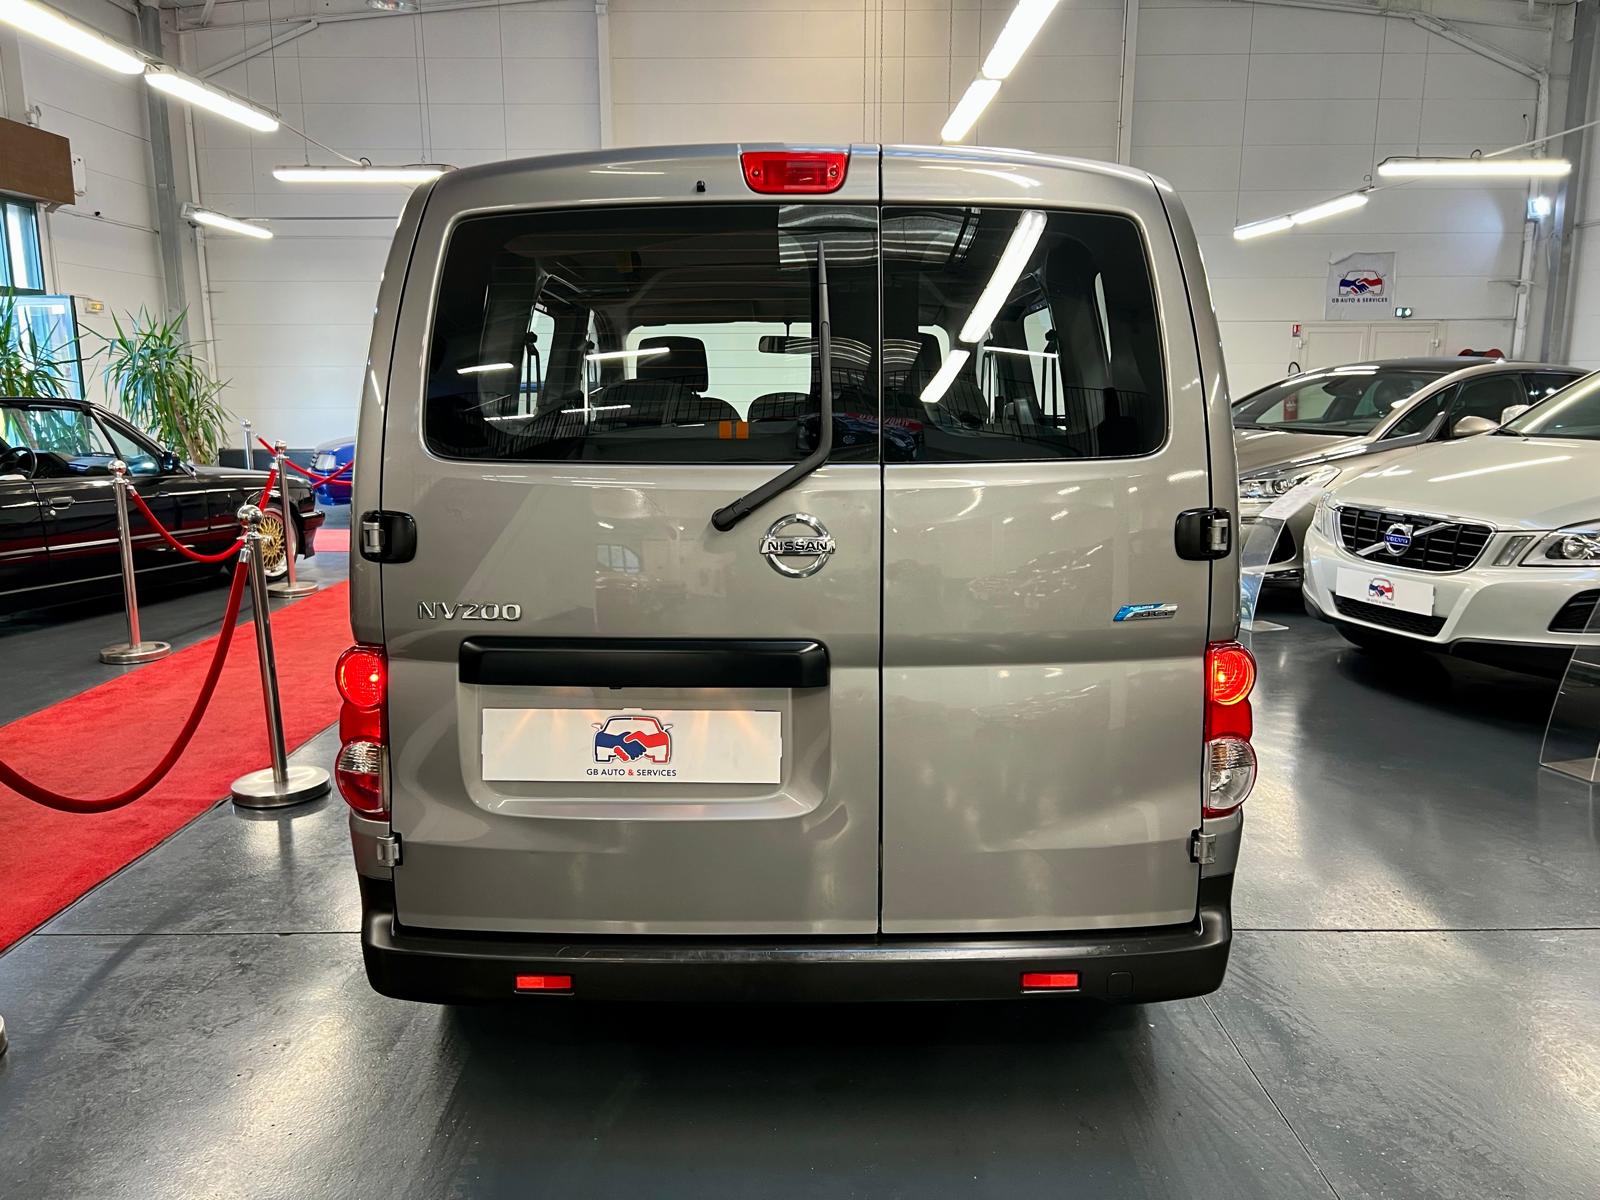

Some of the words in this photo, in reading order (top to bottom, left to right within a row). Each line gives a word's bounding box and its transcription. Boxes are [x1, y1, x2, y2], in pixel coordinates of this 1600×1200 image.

[1385, 535, 1408, 544] VOLVO
[767, 541, 828, 551] NISSAN
[418, 600, 522, 621] NV200
[586, 768, 599, 776] GB
[600, 768, 626, 776] AUTO
[627, 768, 635, 777] &
[636, 768, 677, 777] SERVICES
